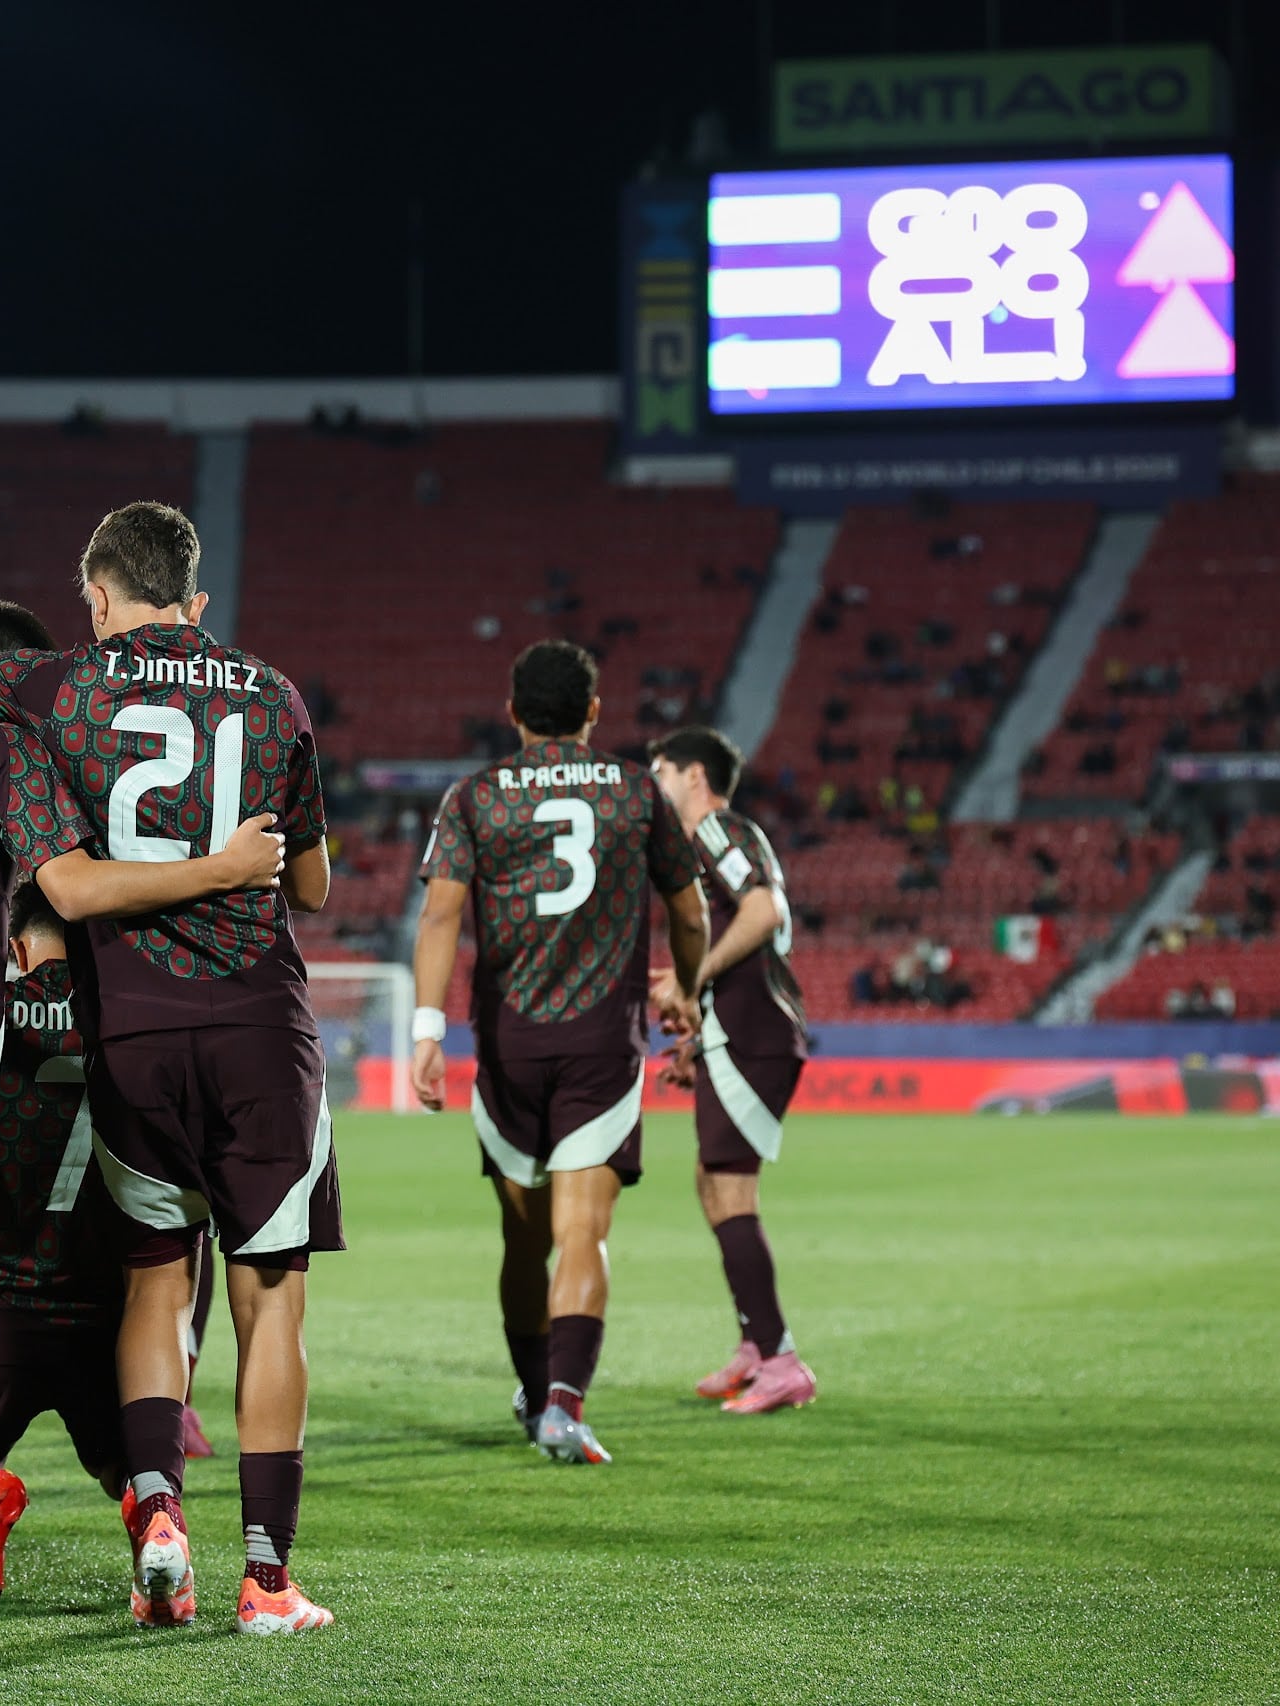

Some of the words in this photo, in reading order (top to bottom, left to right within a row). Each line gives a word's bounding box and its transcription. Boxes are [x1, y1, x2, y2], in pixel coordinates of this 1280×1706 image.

[792, 66, 1189, 130] SANTIAGO
[108, 704, 244, 862] 21
[532, 798, 597, 916] 3
[35, 1055, 93, 1212] 7
